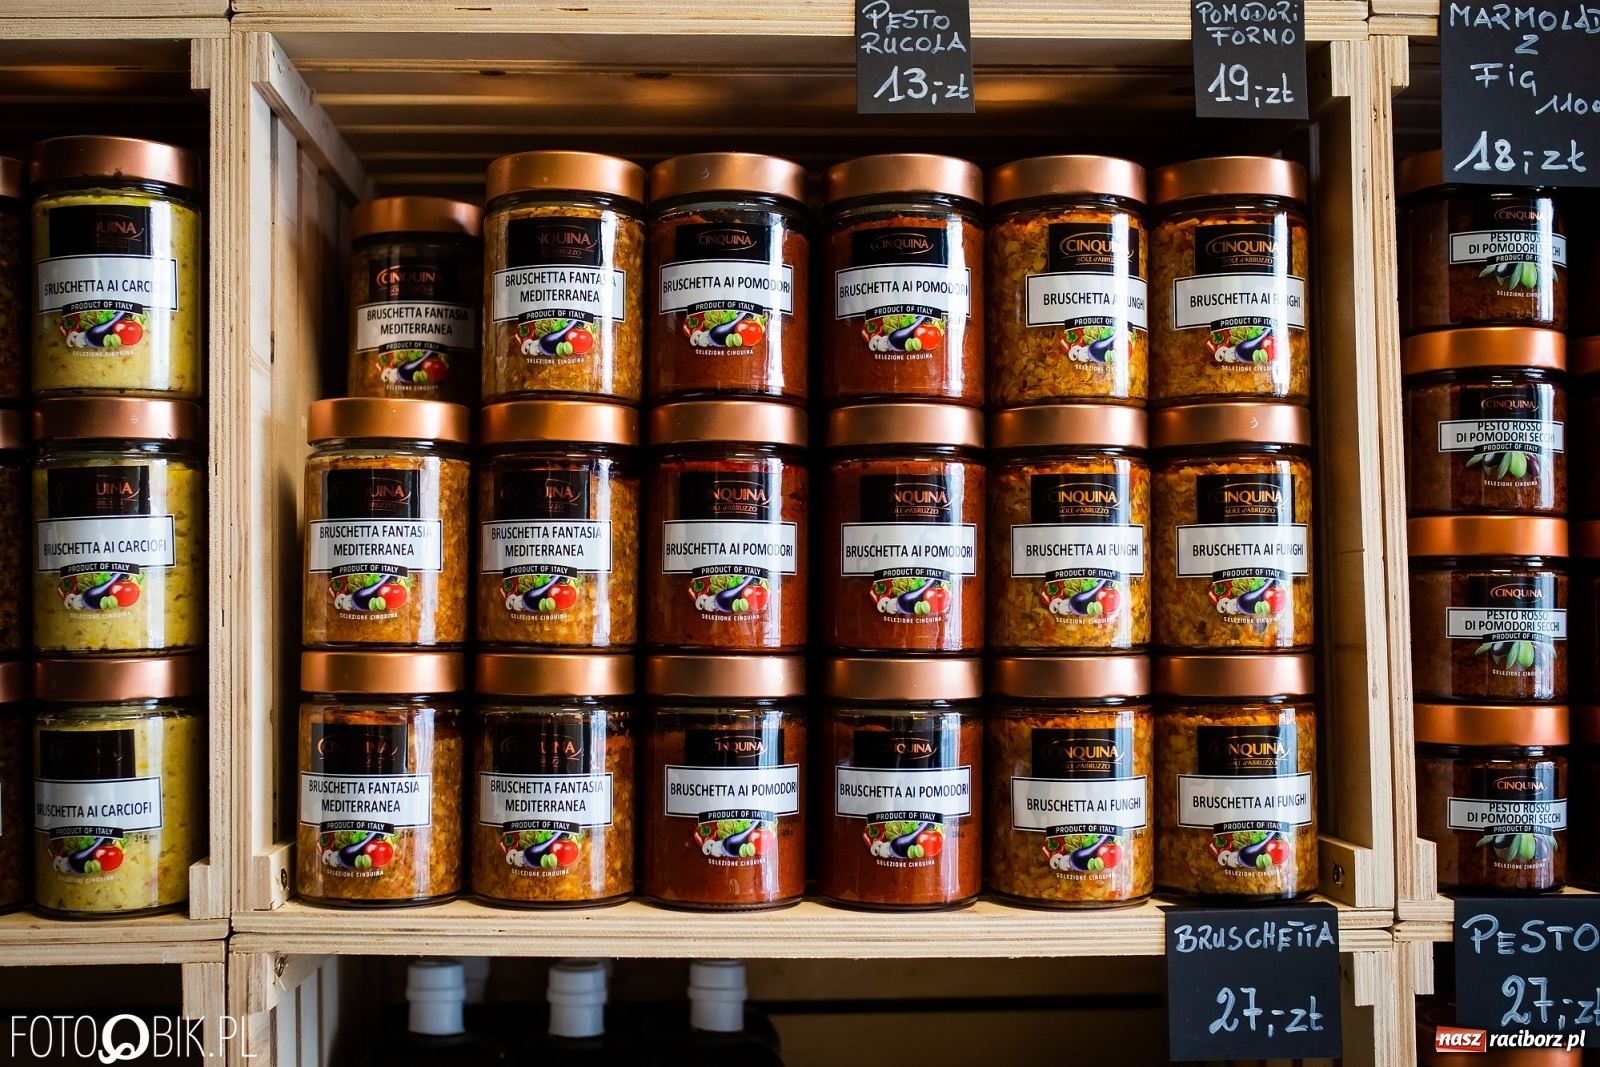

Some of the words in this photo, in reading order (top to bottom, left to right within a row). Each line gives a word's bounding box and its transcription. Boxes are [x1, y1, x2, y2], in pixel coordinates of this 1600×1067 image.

[861, 0, 950, 34] PESTO
[1206, 26, 1295, 46] FORNO
[860, 31, 967, 54] RUCOLA
[698, 235, 751, 245] CINQUINA
[1491, 233, 1521, 242] PESTO
[875, 239, 929, 249] CINQUINA
[1469, 244, 1479, 254] DI
[1483, 243, 1537, 253] POMODORI
[505, 271, 566, 287] BRUSCHETTA
[663, 276, 721, 294] BRUSCHETTA
[724, 276, 734, 288] AI
[738, 277, 790, 294] POMODORI
[44, 279, 104, 296] BRUSCHETTA
[107, 279, 118, 292] AI
[840, 281, 899, 298] BRUSCHETTA
[902, 281, 912, 292] AI
[520, 289, 599, 302] MEDITERRANEA
[1043, 292, 1110, 306] BRUSCHETTA
[1190, 293, 1258, 308] BRUSCHETTA
[1261, 293, 1270, 304] AI
[71, 301, 101, 311] PRODUCT
[116, 301, 133, 310] ITALY
[695, 301, 725, 310] PRODUCT
[738, 302, 755, 310] ITALY
[874, 306, 903, 315] PRODUCT
[917, 306, 933, 314] ITALY
[367, 307, 422, 321] BRUSCHETTA
[425, 307, 469, 320] FANTASIA
[1220, 318, 1250, 327] PRODUCT
[380, 323, 453, 335] MEDITERRANEA
[1478, 422, 1509, 431] PESTO
[1512, 422, 1542, 431] ROSSO
[1456, 433, 1466, 442] DI
[1470, 432, 1527, 442] POMODORI
[1483, 443, 1512, 452] PRODUCT
[1524, 444, 1538, 452] ITALY
[320, 526, 379, 538] BRUSCHETTA
[382, 526, 432, 538] FANTASIA
[492, 526, 549, 540] BRUSCHETTA
[552, 527, 602, 538] FANTASIA
[44, 542, 100, 556] BRUSCHETTA
[103, 541, 114, 553] AI
[118, 539, 167, 553] CARCIOFI
[334, 544, 414, 556] MEDITERRANEA
[505, 545, 584, 557] MEDITERRANEA
[666, 543, 726, 555] BRUSCHETTA
[730, 543, 740, 554] AI
[743, 543, 793, 557] POMODORI
[846, 545, 908, 558] BRUSCHETTA
[911, 545, 921, 557] AI
[925, 545, 973, 558] POMODORI
[1026, 544, 1093, 557] BRUSCHETTA
[1096, 544, 1106, 556] AI
[1109, 544, 1139, 556] FUNGHI
[1193, 544, 1261, 556] BRUSCHETTA
[1264, 544, 1273, 556] AI
[1276, 544, 1303, 556] FUNGHI
[701, 566, 731, 575] PRODUCT
[745, 566, 761, 575] ITALY
[883, 569, 913, 577] PRODUCT
[927, 569, 942, 577] ITALY
[1055, 569, 1085, 578] PRODUCT
[1099, 570, 1114, 578] ITALY
[1223, 569, 1253, 578] PRODUCT
[1265, 570, 1281, 578] ITALY
[1495, 589, 1543, 599] CINQUINA
[1487, 610, 1518, 620] PESTO
[1521, 611, 1548, 621] ROSSO
[1465, 620, 1475, 630] DI
[1479, 621, 1534, 631] POMODORI
[1537, 621, 1559, 631] SECCHI
[309, 780, 365, 794] BRUSCHETTA
[368, 781, 420, 794] FANTASIA
[491, 780, 551, 794] BRUSCHETTA
[555, 780, 604, 794] FANTASIA
[670, 783, 735, 796] BRUSCHETTA
[738, 785, 748, 796] AI
[752, 782, 797, 796] POMODOR
[840, 783, 902, 797] BRUSCHETTA
[905, 787, 915, 797] AI
[919, 783, 969, 797] POMODORI
[1497, 781, 1544, 791] CINQUINA
[322, 799, 401, 812] MEDITERRANEA
[505, 799, 586, 812] MEDITERRANEA
[1027, 798, 1094, 812] BRUSCHETTA
[1097, 799, 1107, 811] AI
[1110, 797, 1141, 811] FUNGHI
[1193, 796, 1261, 809] BRUSCHETTA
[1265, 796, 1274, 808] AI
[1277, 793, 1307, 807] FUNGHI
[87, 805, 98, 818] AI
[101, 802, 152, 817] CARCIOFI
[1489, 803, 1520, 813] PESTO
[1523, 803, 1550, 813] ROSSO
[708, 811, 738, 819] PRODUCT
[751, 811, 766, 819] ITALY
[876, 812, 906, 820] PRODUCT
[1467, 812, 1478, 822] DI
[1481, 813, 1536, 824] POMODORI
[1539, 813, 1561, 823] SECCHI
[1055, 825, 1086, 833] PRODUCT
[1223, 822, 1254, 830] PRODUCT
[1174, 920, 1336, 953] BRUSCHETTA
[1462, 913, 1600, 955] PESTO
